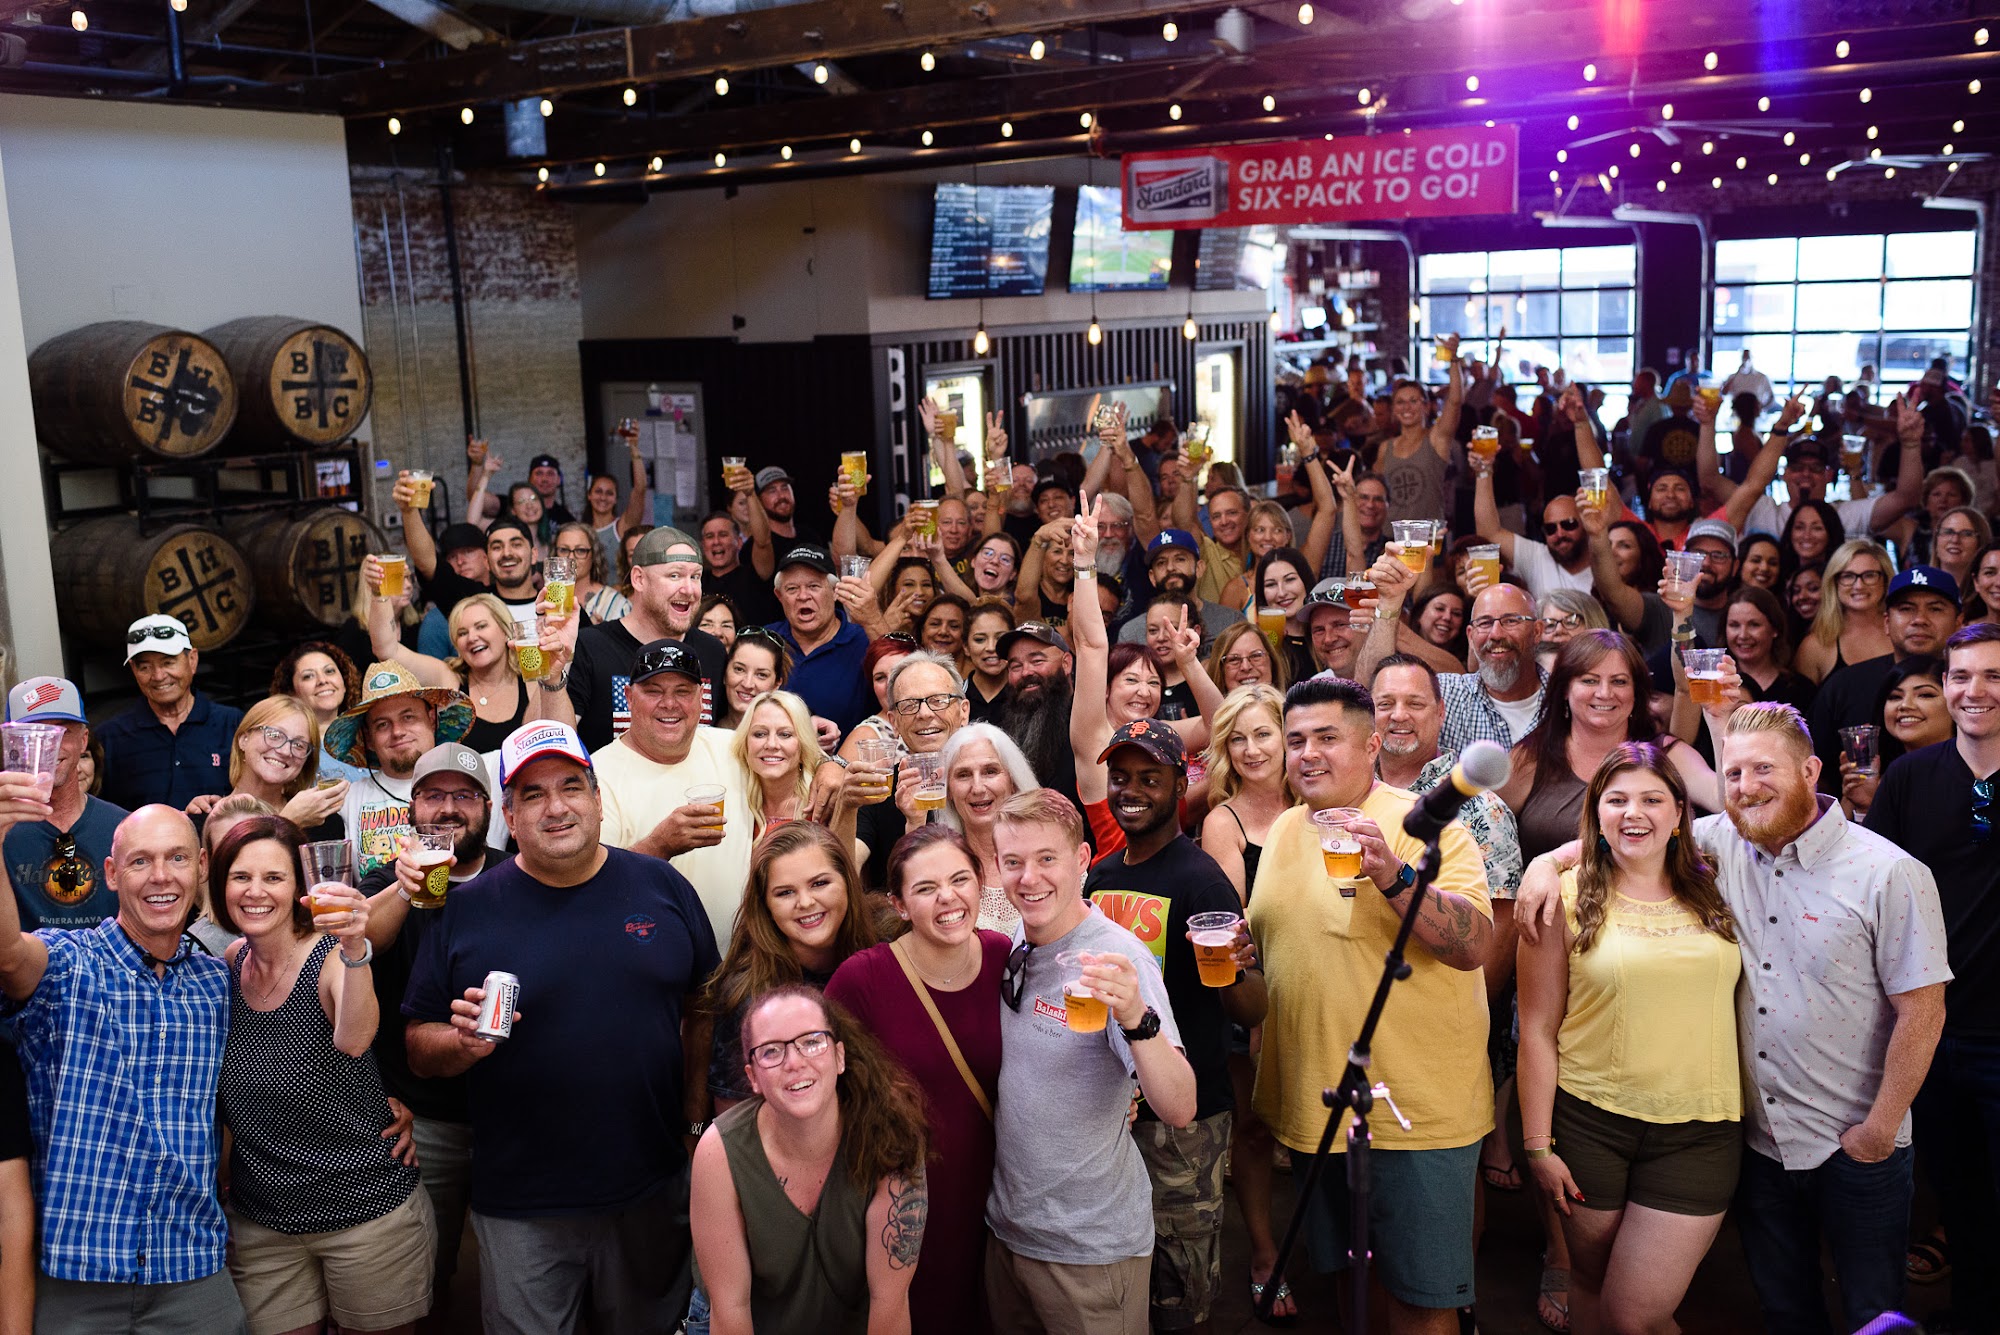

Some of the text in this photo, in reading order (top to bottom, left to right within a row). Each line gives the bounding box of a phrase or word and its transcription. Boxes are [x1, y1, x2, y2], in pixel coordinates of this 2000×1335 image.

[1239, 141, 1508, 184] GRAB AN ICE COLD
[1136, 167, 1212, 211] Standard
[1238, 172, 1480, 212] SIX-PACK TO GO!
[291, 352, 309, 374] B
[295, 396, 350, 419] B C
[158, 546, 221, 593] B H
[1911, 569, 1928, 585] LA
[215, 589, 238, 613] C
[515, 727, 567, 756] Standard
[211, 753, 221, 767] B
[360, 807, 409, 831] HUNDR
[55, 889, 84, 898] HOTEL
[39, 915, 103, 925] RIVIERA MAYA
[500, 982, 513, 1035] Standard
[1035, 1000, 1067, 1021] Balashi
